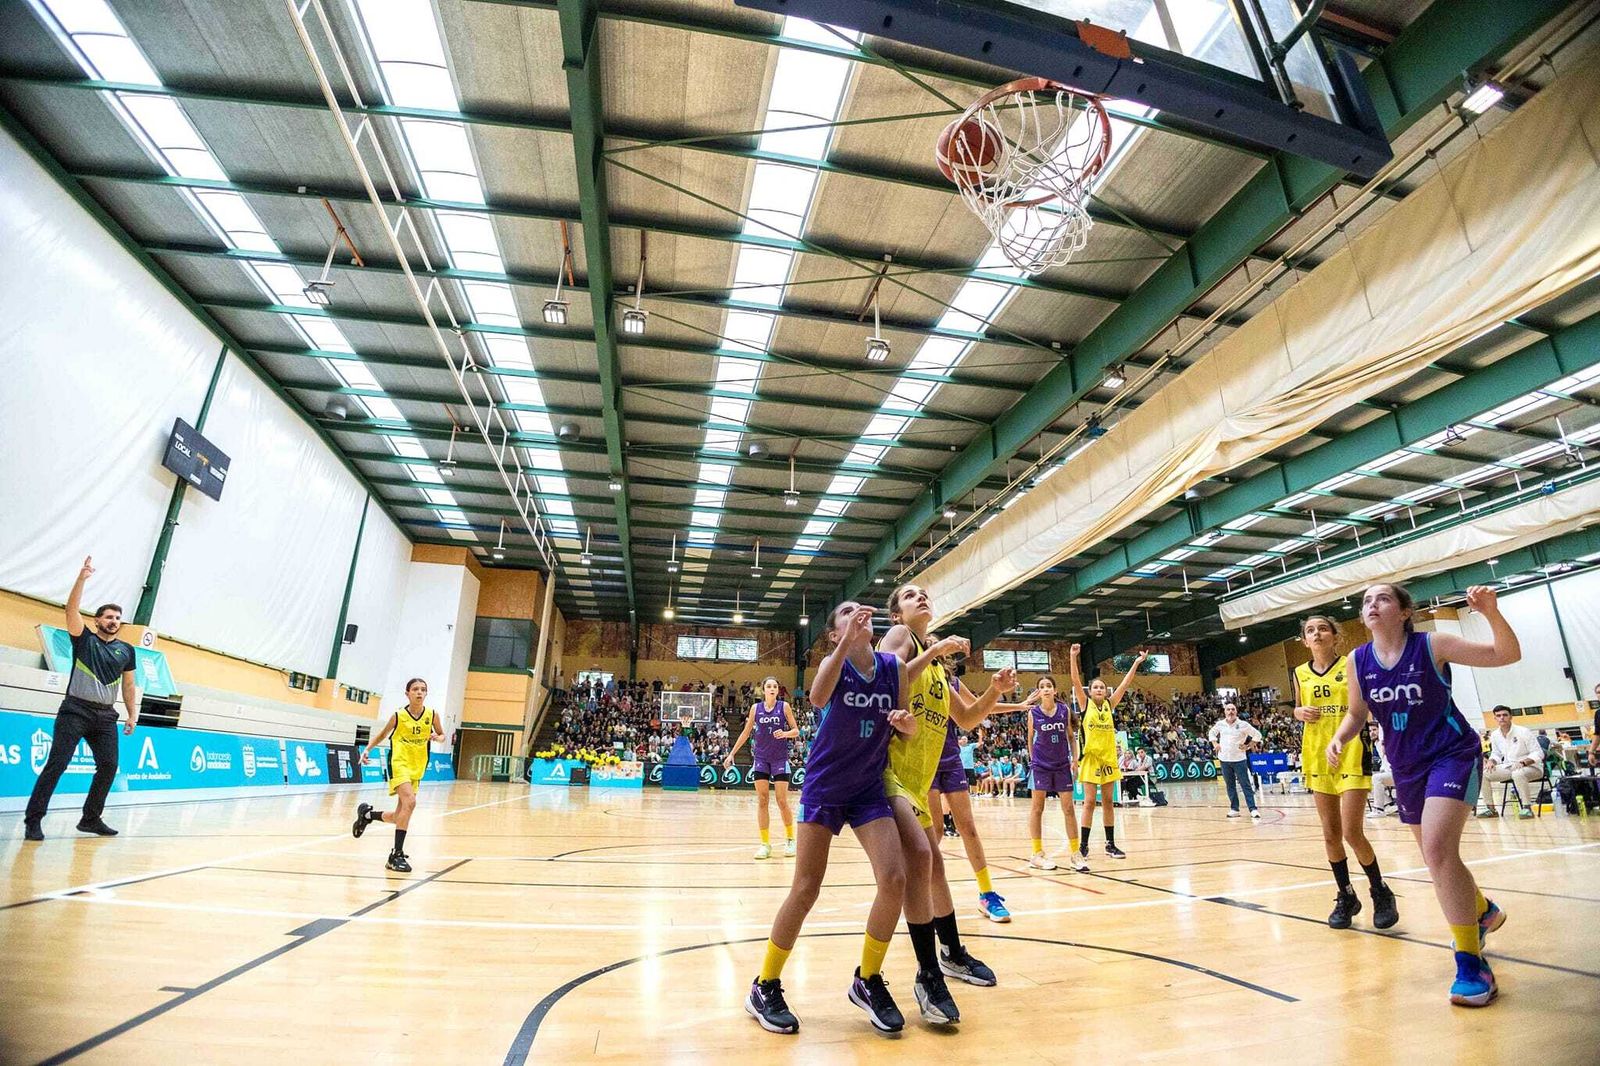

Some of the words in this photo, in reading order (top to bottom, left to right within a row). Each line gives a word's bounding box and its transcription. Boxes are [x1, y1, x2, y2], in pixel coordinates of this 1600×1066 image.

[174, 440, 192, 458] LOCAL
[1313, 684, 1331, 698] 26
[412, 726, 421, 735] 15
[859, 719, 875, 738] 16
